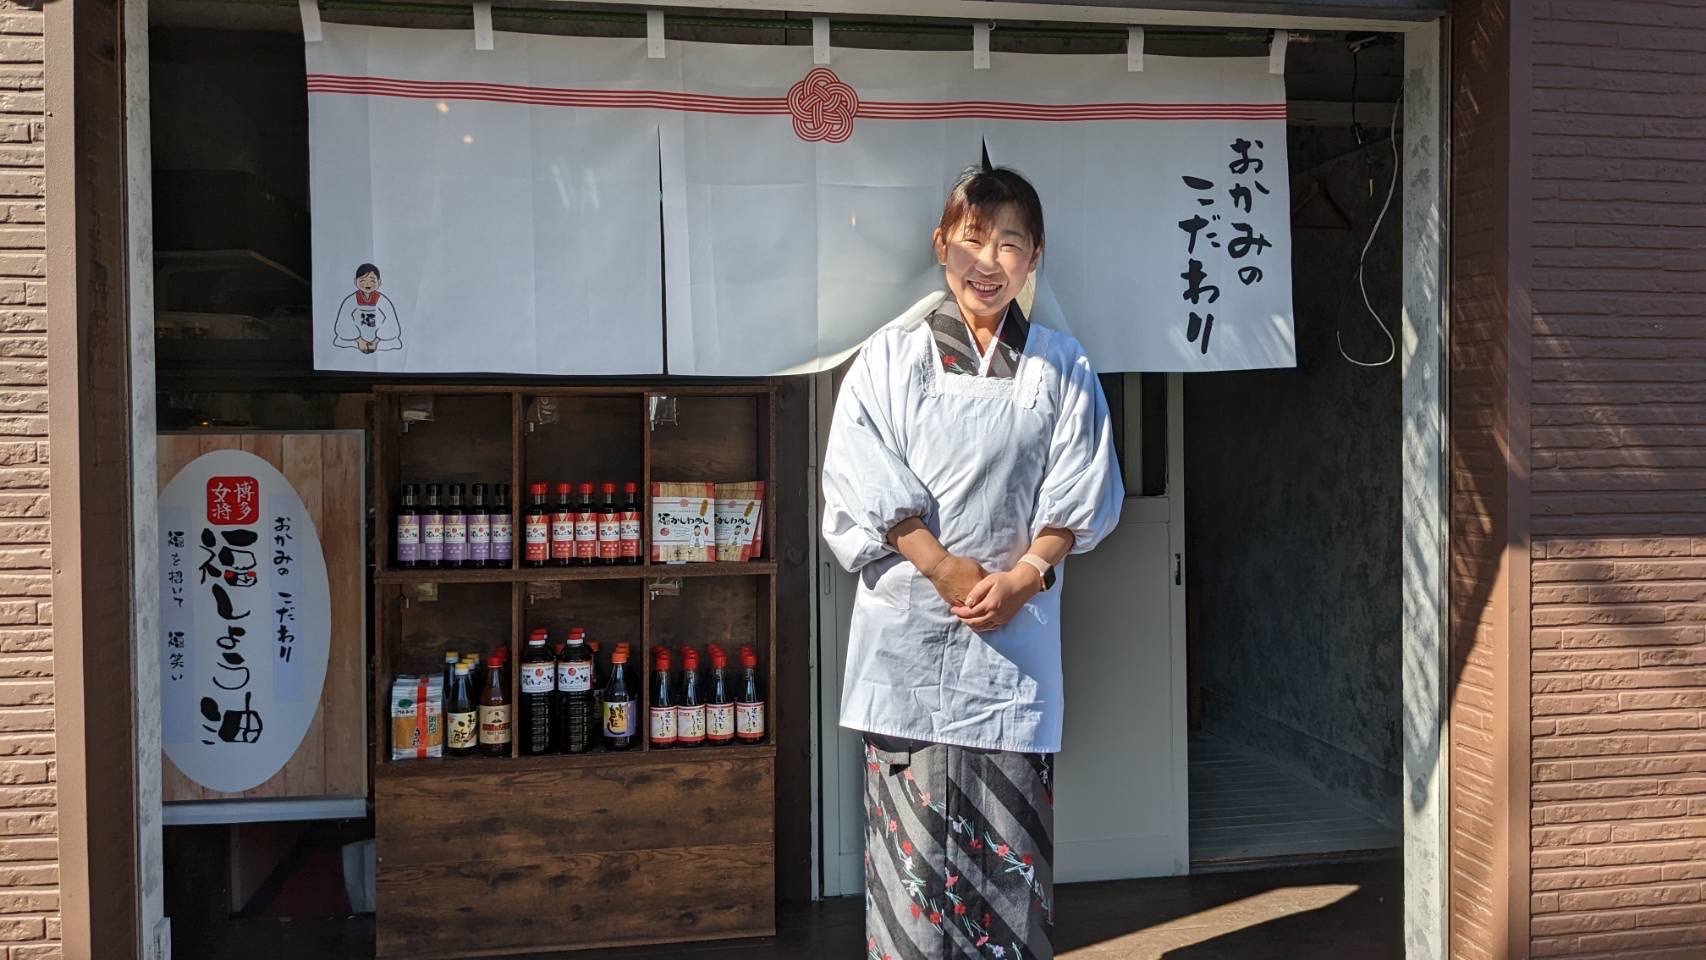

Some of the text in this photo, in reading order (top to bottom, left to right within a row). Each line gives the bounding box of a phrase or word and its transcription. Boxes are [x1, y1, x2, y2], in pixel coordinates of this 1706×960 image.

[1178, 175, 1220, 355] こだわり
[1227, 137, 1272, 285] おかみの
[211, 482, 232, 520] 女将
[233, 480, 255, 521] 博多
[167, 530, 185, 681] 福を招いて 福笑い
[198, 527, 263, 746] 福しょう油
[273, 516, 296, 663] おかみの こだわり
